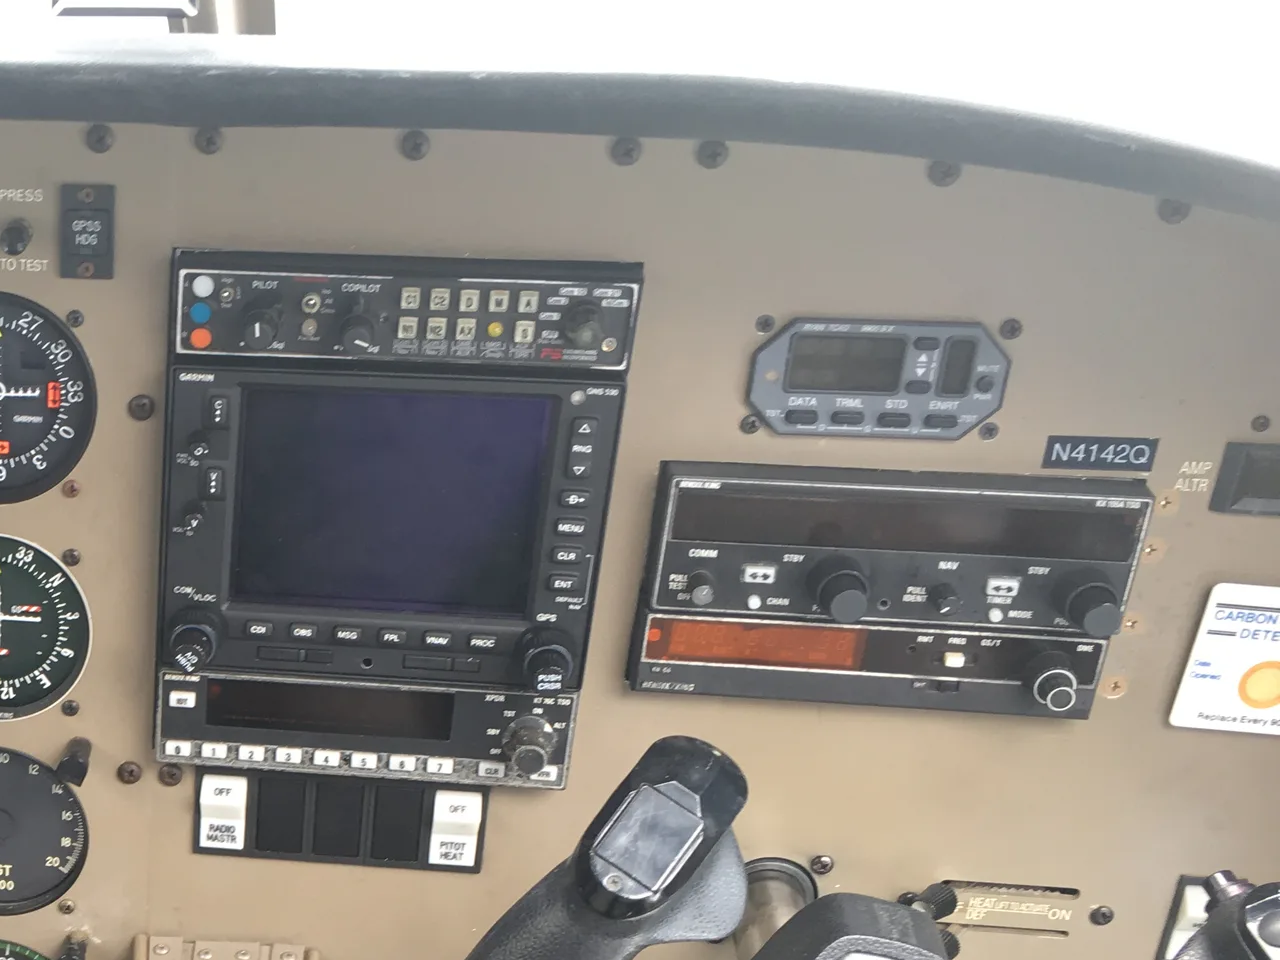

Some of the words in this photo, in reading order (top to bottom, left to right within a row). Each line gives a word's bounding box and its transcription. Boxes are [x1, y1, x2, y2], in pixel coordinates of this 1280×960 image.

[0, 189, 43, 202] PRESS
[72, 221, 101, 232] GPSS
[75, 234, 97, 244] HDG
[0, 259, 17, 270] TO
[20, 260, 49, 271] TEST
[252, 281, 278, 289] PILOT
[341, 283, 381, 292] COPILOT
[18, 311, 44, 330] 27
[977, 365, 999, 373] MUTE
[179, 373, 215, 382] GARMIN
[788, 397, 818, 407] DATA
[885, 400, 908, 409] STD
[929, 401, 960, 411] ENRT
[13, 415, 43, 423] GARMIN
[1051, 443, 1150, 465] N4142Q
[1180, 461, 1213, 474] AMP
[1174, 478, 1209, 492] ALTR
[557, 523, 584, 532] MENU
[557, 552, 576, 560] CLR
[689, 549, 718, 558] COMM
[783, 554, 805, 562] STBY
[938, 561, 959, 570] NAV
[1027, 566, 1051, 575] STBY
[670, 574, 688, 582] PULL
[554, 580, 573, 588] ENT
[669, 582, 687, 590] TEST
[906, 586, 926, 594] PULL
[767, 597, 790, 606] CHAN
[902, 594, 928, 603] IDENT
[987, 596, 1012, 605] TIMER
[536, 613, 557, 622] GPS
[1008, 610, 1033, 619] MODE
[1215, 610, 1279, 624] CARBON
[250, 626, 266, 634] CDI
[293, 629, 312, 637] OBS
[1240, 628, 1280, 641] DETE
[337, 631, 358, 639] MSG
[384, 634, 400, 642] FPL
[917, 635, 935, 643] RMT
[426, 637, 449, 645] VNAV
[470, 639, 495, 647] PROC
[948, 637, 966, 645] FREQ
[980, 638, 1002, 647] GS/T
[1077, 644, 1094, 653] DME
[1190, 671, 1221, 680] Opened
[538, 682, 561, 690] CRSR
[1197, 712, 1237, 722] Replace
[1240, 716, 1268, 726] Every
[0, 753, 10, 763] 10
[29, 764, 39, 775] 12
[214, 788, 232, 796] OFF
[449, 806, 466, 814] OFF
[62, 811, 73, 821] 16
[209, 824, 236, 834] RADIO
[61, 837, 71, 847] 18
[206, 834, 237, 844] MASTR
[440, 842, 466, 851] PITOT
[440, 852, 463, 860] HEAT
[45, 857, 60, 867] 20
[969, 898, 998, 907] HEAT
[966, 909, 986, 920] DEF
[1048, 909, 1072, 920] ON
